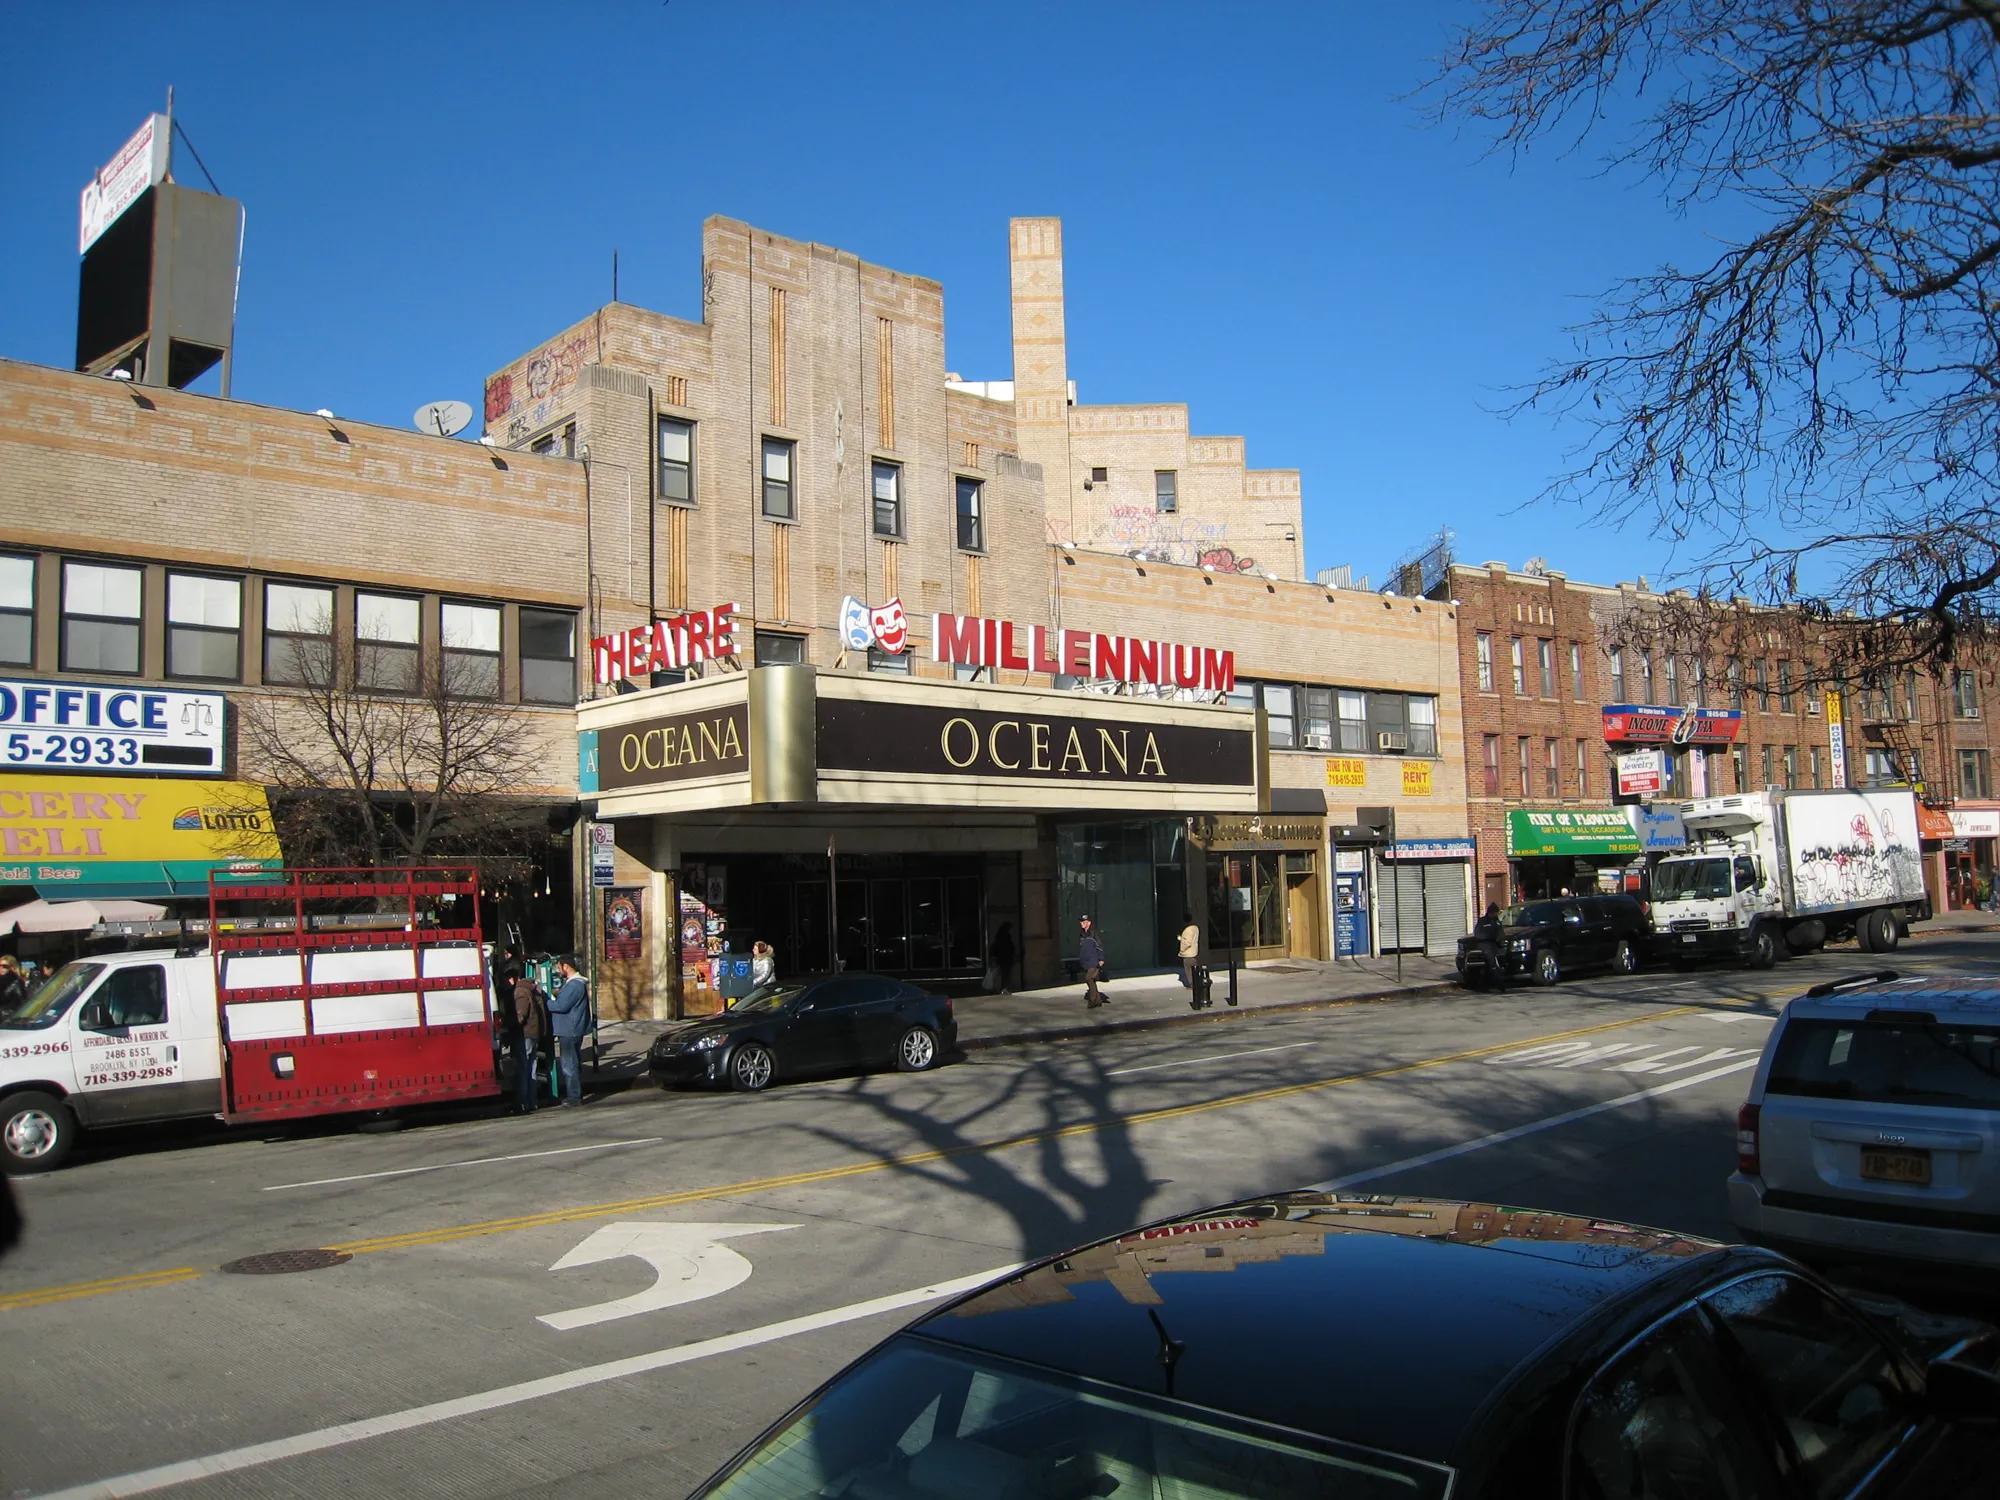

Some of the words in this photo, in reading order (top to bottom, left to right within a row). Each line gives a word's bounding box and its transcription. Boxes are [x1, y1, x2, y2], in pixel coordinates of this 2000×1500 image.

[591, 602, 741, 685] THEATRE
[932, 612, 1234, 691] MILLENNIUM
[0, 686, 168, 730] OFFICE
[1628, 716, 1669, 732] INCOME
[1696, 720, 1715, 733] TAX
[7, 734, 139, 765] 5-2933
[619, 717, 744, 773] OCEANA
[940, 717, 1168, 777] OCEANA
[1831, 726, 1842, 759] ROMANO
[1326, 760, 1340, 772] STORE
[1342, 760, 1352, 772] FOR
[1353, 761, 1364, 773] RENT
[1402, 762, 1418, 770] OFFICE
[1622, 759, 1655, 771] Jewelry
[1328, 774, 1364, 785] 718-615-2933
[1403, 772, 1428, 783] RENT
[204, 814, 261, 830] LOTTO
[1527, 813, 1554, 825] ART
[1556, 813, 1570, 825] OF
[1573, 813, 1628, 826] FLOWERS
[1643, 809, 1675, 824] Brighton
[1505, 812, 1514, 854] FLOWERS
[1646, 829, 1683, 847] Jewelry
[1, 828, 107, 857] ELI
[39, 867, 82, 880] Beer
[83, 1036, 116, 1048] AFFORDABLE
[134, 1033, 139, 1042] &
[139, 1032, 159, 1041] MIRROR
[105, 1049, 126, 1059] 2486
[1483, 1041, 1763, 1075] ONLY
[129, 1060, 138, 1068] NY
[84, 1066, 173, 1086] 718-339-2988
[1878, 1131, 1906, 1145] Jeep
